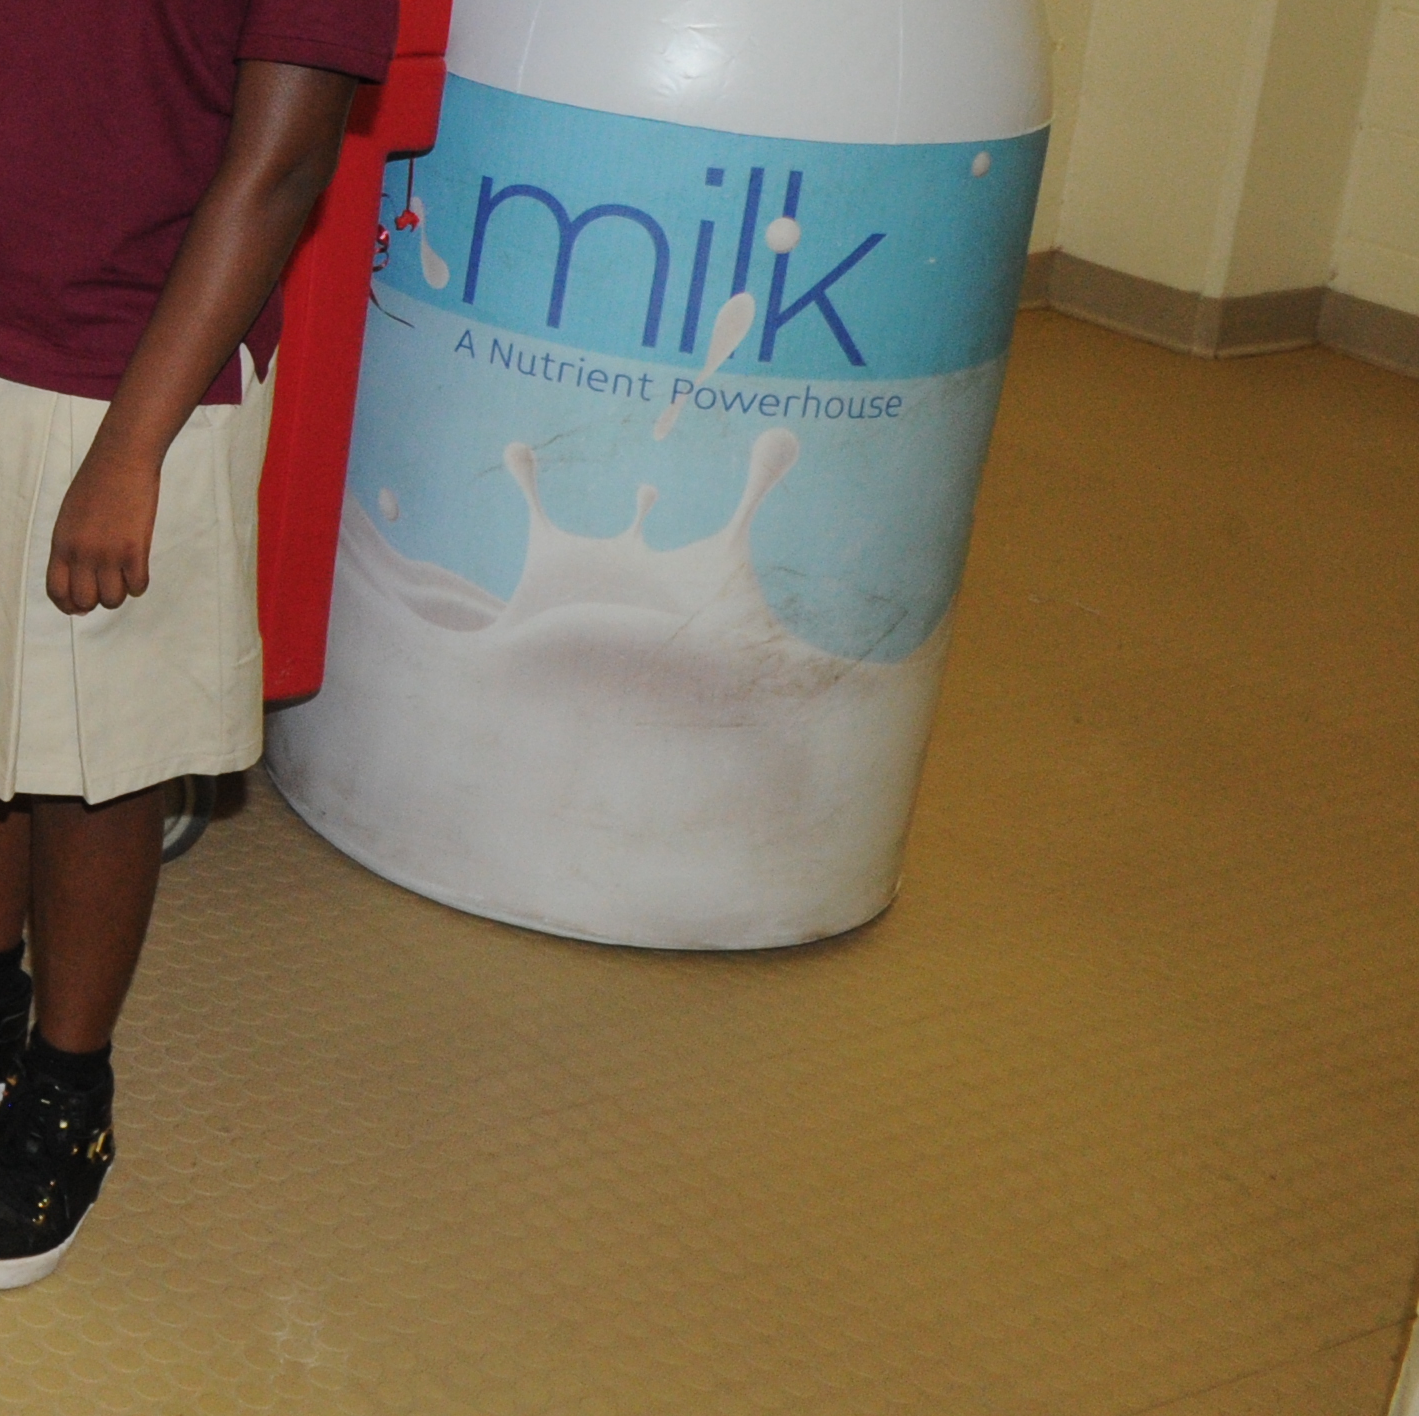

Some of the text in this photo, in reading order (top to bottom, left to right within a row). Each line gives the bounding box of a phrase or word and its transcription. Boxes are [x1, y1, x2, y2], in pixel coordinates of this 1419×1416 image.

[463, 166, 888, 369] milk
[454, 329, 906, 421] A Nutrient Powerhouse
